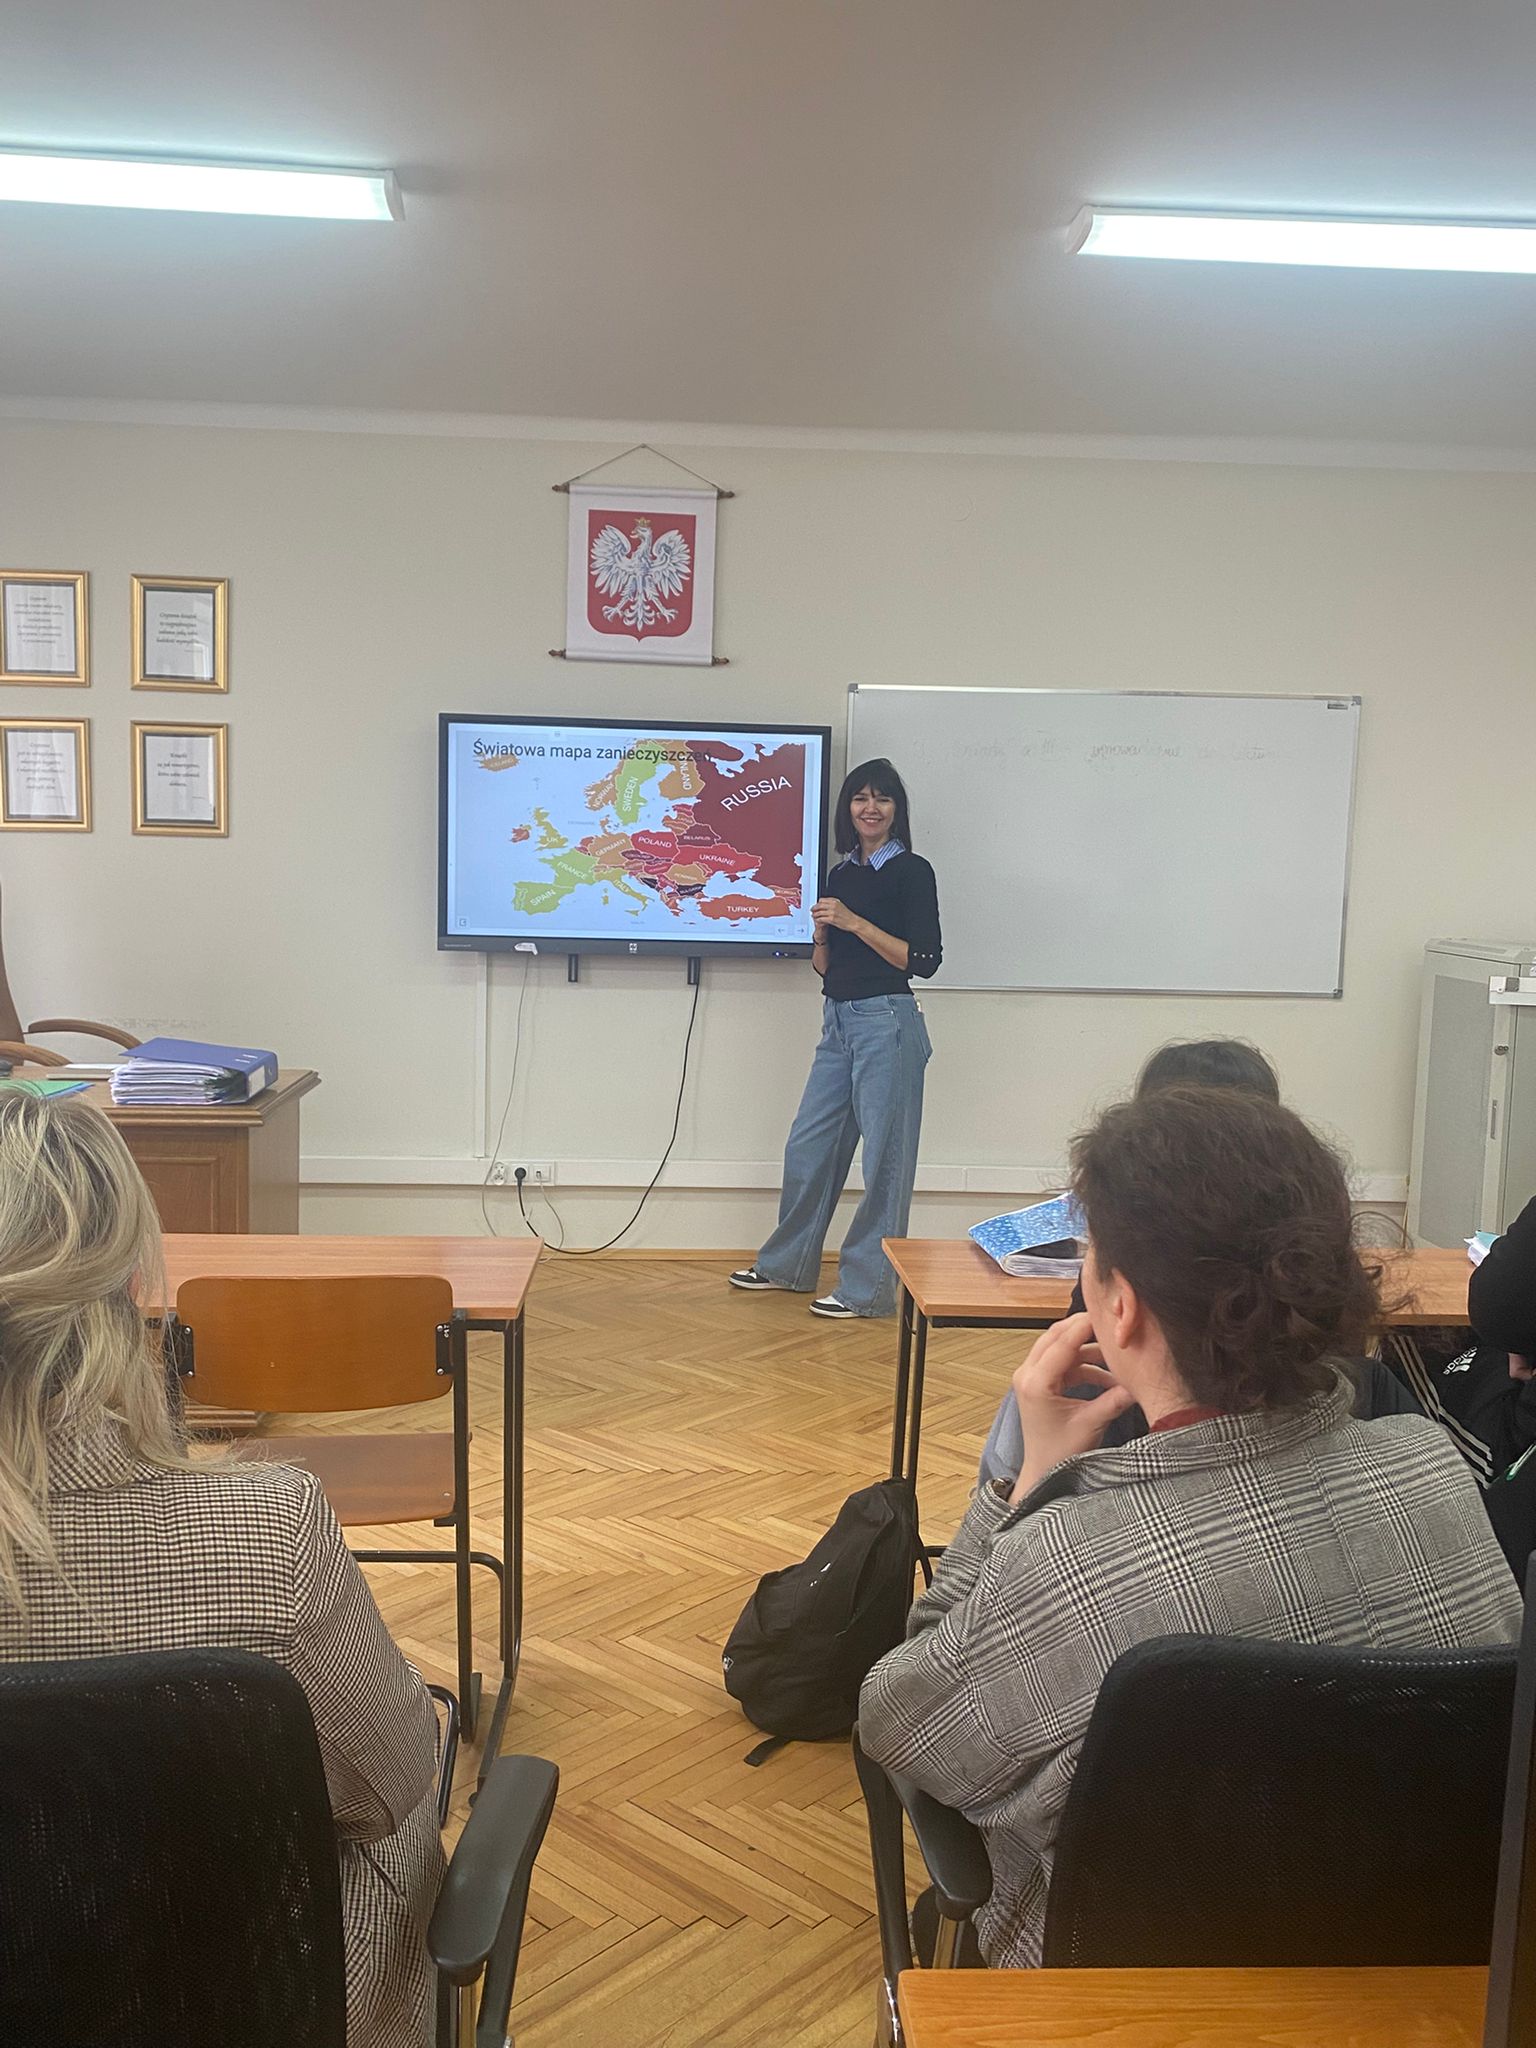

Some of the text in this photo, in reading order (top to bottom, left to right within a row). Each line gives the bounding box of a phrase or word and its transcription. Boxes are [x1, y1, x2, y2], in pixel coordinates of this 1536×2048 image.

[473, 738, 712, 764] Światowa mapa zanieczyszczeń
[622, 776, 639, 812] SWEDEN
[720, 776, 792, 812] RUSSIA
[595, 838, 627, 857] GERMANY
[638, 836, 673, 850] POLAND
[699, 854, 736, 866] UKRAINE
[556, 861, 590, 880] FRANCE
[529, 888, 557, 907] SPAIN
